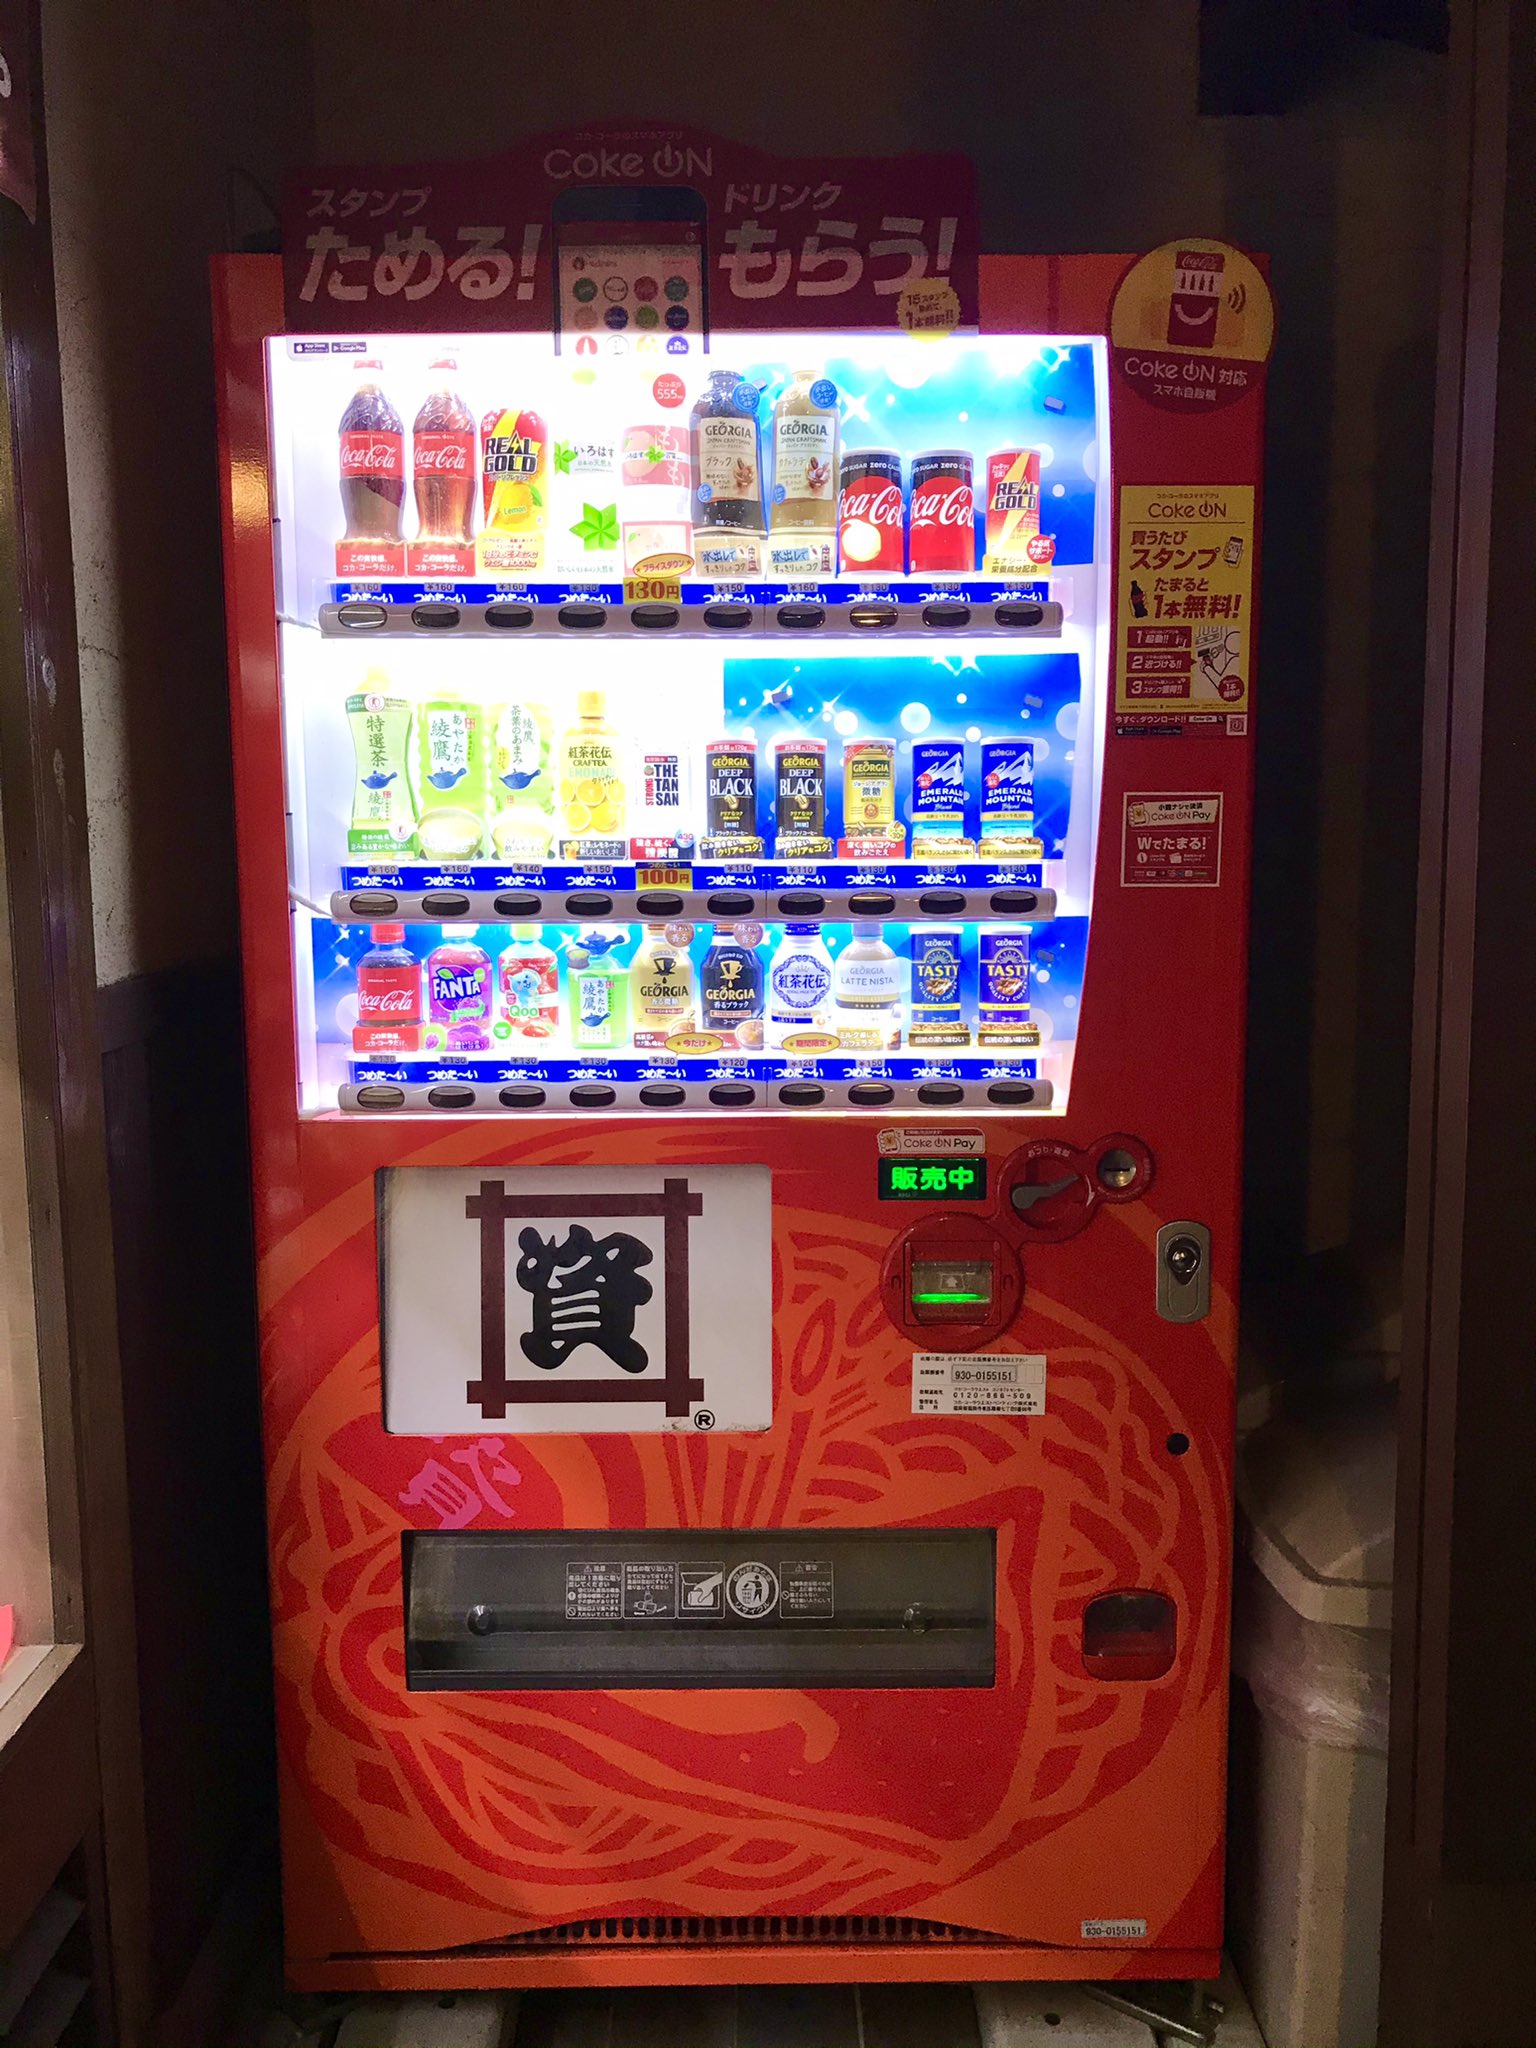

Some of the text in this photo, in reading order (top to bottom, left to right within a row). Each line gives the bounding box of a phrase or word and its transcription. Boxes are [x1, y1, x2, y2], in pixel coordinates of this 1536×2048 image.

[543, 142, 712, 179] Coke ON
[306, 186, 432, 218] スタンプ
[724, 181, 842, 213] ドリンク
[300, 224, 543, 302] ためる!
[1181, 254, 1218, 270] Coca-Cola
[1124, 357, 1248, 386] Coke ON 対応
[1153, 384, 1217, 401] スマホ自販機
[705, 421, 752, 438] GEORGIA
[780, 419, 829, 436] GEORGIA
[485, 431, 538, 455] REAL
[341, 444, 398, 470] Coca-Cola
[414, 444, 466, 470] Coca-Cola
[573, 445, 614, 458] いろはす
[484, 455, 538, 473] GOLD
[705, 456, 732, 466] ブラック
[849, 463, 867, 471] SUGAR
[919, 463, 939, 471] SUGAR
[997, 479, 1036, 496] REAL
[503, 506, 527, 515] Lemon
[994, 495, 1035, 511] GOLD
[1148, 500, 1227, 518] Coke ON
[1131, 530, 1188, 546] 買うたび
[643, 559, 684, 573] プライスダウン
[1129, 546, 1221, 571] スタンプ
[625, 580, 679, 600] 130円
[1154, 577, 1209, 592] たまると
[1154, 594, 1242, 619] 1本無料!
[1136, 630, 1142, 644] 1
[1131, 655, 1142, 669] 2
[1144, 660, 1182, 669] 近づける!!
[1131, 680, 1142, 694] 3
[365, 715, 389, 768] 特選茶
[430, 718, 452, 762] 綾鷹
[452, 713, 465, 765] あやたか
[510, 704, 523, 765] 茶葉のあまみ
[568, 746, 612, 759] 紅茶花伝
[573, 759, 608, 767] CRAFTEA
[712, 755, 749, 767] GEORGIA
[783, 755, 819, 767] GEORGIA
[853, 761, 889, 773] GEORGIA
[654, 763, 679, 778] THE
[718, 769, 743, 777] DEEP
[789, 769, 814, 777] DEEP
[655, 778, 679, 792] TAN
[709, 778, 753, 796] BLACK
[780, 778, 823, 796] BLACK
[920, 787, 963, 797] EMERALD
[988, 787, 1032, 797] EMERALD
[655, 792, 679, 807] SAN
[1151, 812, 1175, 821] Coke
[1192, 810, 1211, 820] Pay
[639, 869, 690, 884] 100円
[671, 935, 688, 943] 香る
[741, 935, 757, 943] 香る
[925, 938, 952, 947] GEORGIA
[995, 938, 1023, 947] GEORGIA
[917, 965, 958, 977] TASTY
[987, 965, 1029, 977] TASTY
[433, 976, 481, 1000] FANTA
[778, 974, 826, 989] 紅茶花伝
[841, 976, 894, 985] LATTE NISTA
[640, 982, 689, 997] GEORGIA
[705, 986, 755, 1001] GEORGIA
[358, 988, 416, 1012] Coca-Cola
[713, 1001, 750, 1009] 香るブラック
[509, 1004, 539, 1018] Qoo
[683, 1039, 706, 1048] 今だけ
[903, 1137, 976, 1150] Coke ON Pay
[890, 1166, 974, 1191] 販売中
[954, 1370, 1012, 1381] 930-0155151
[735, 1601, 771, 1615] リサイクル
